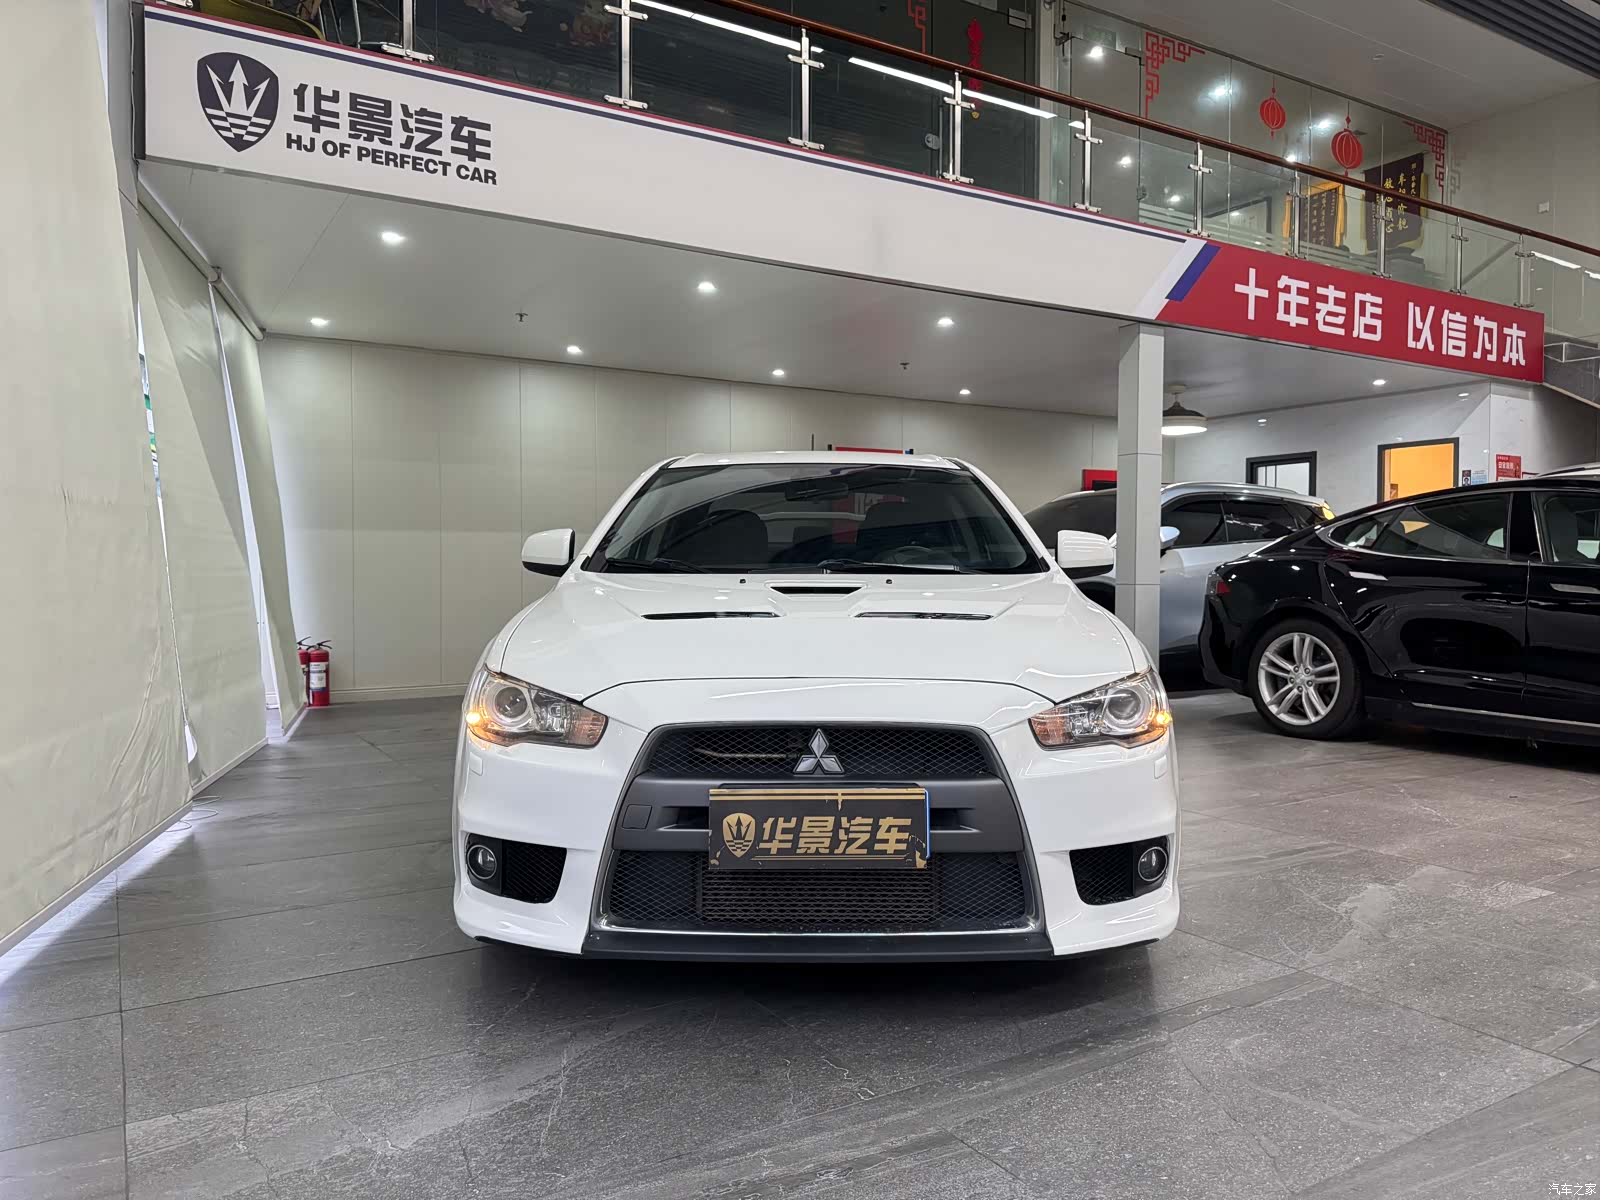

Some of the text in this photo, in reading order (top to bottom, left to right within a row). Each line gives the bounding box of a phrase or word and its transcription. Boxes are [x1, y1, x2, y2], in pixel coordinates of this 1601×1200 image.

[293, 83, 491, 162] 华景汽车
[286, 133, 497, 185] HJ OF PERFECT CAR
[1234, 267, 1526, 366] 十年老店 以信为本
[759, 816, 912, 855] 华景汽车
